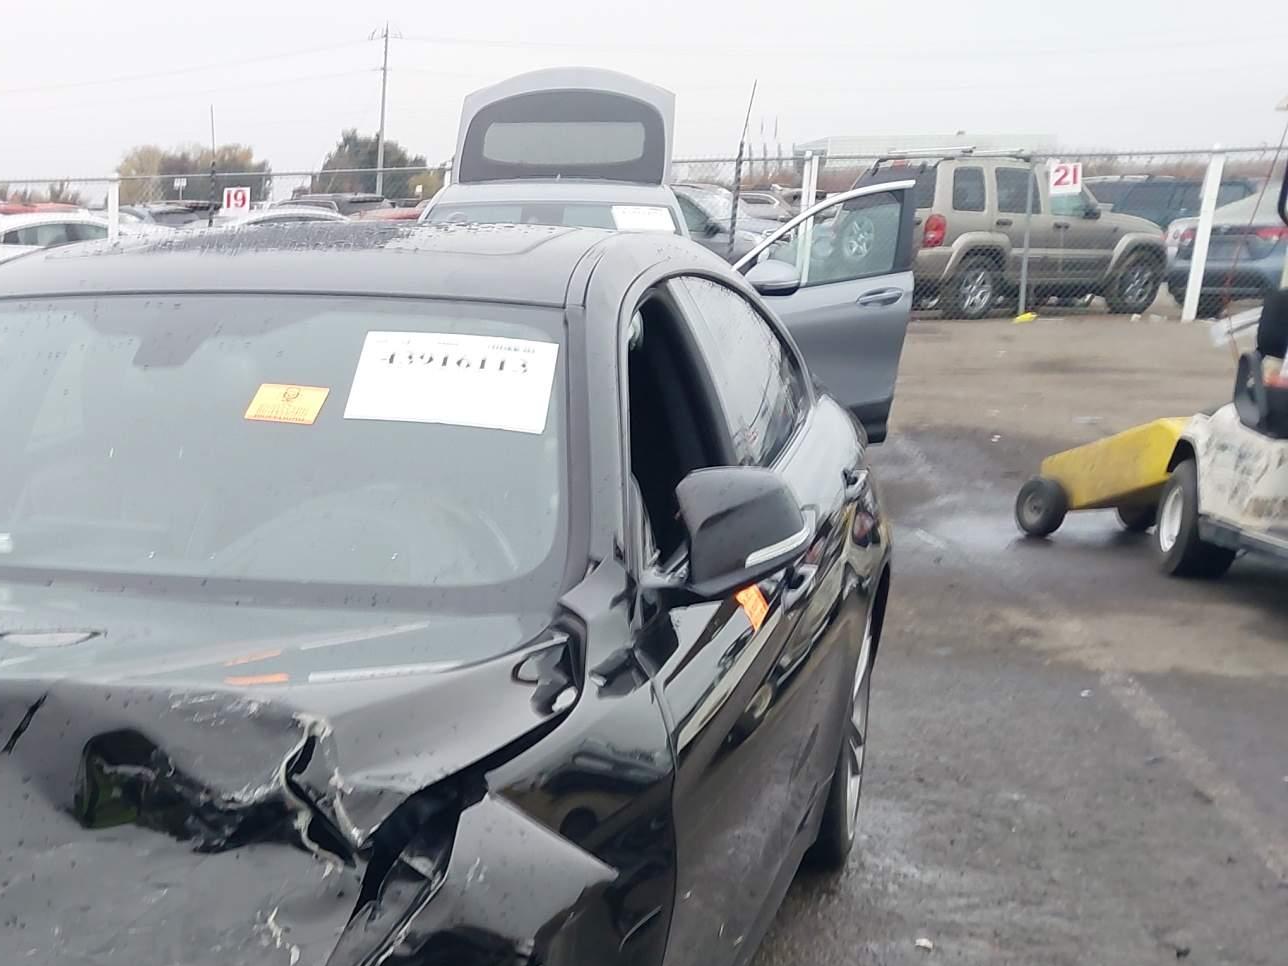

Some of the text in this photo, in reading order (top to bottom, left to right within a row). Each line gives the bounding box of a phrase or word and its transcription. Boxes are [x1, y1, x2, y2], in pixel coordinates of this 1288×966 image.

[1053, 165, 1079, 187] 21
[226, 189, 246, 209] 19
[380, 351, 529, 375] 43916113
